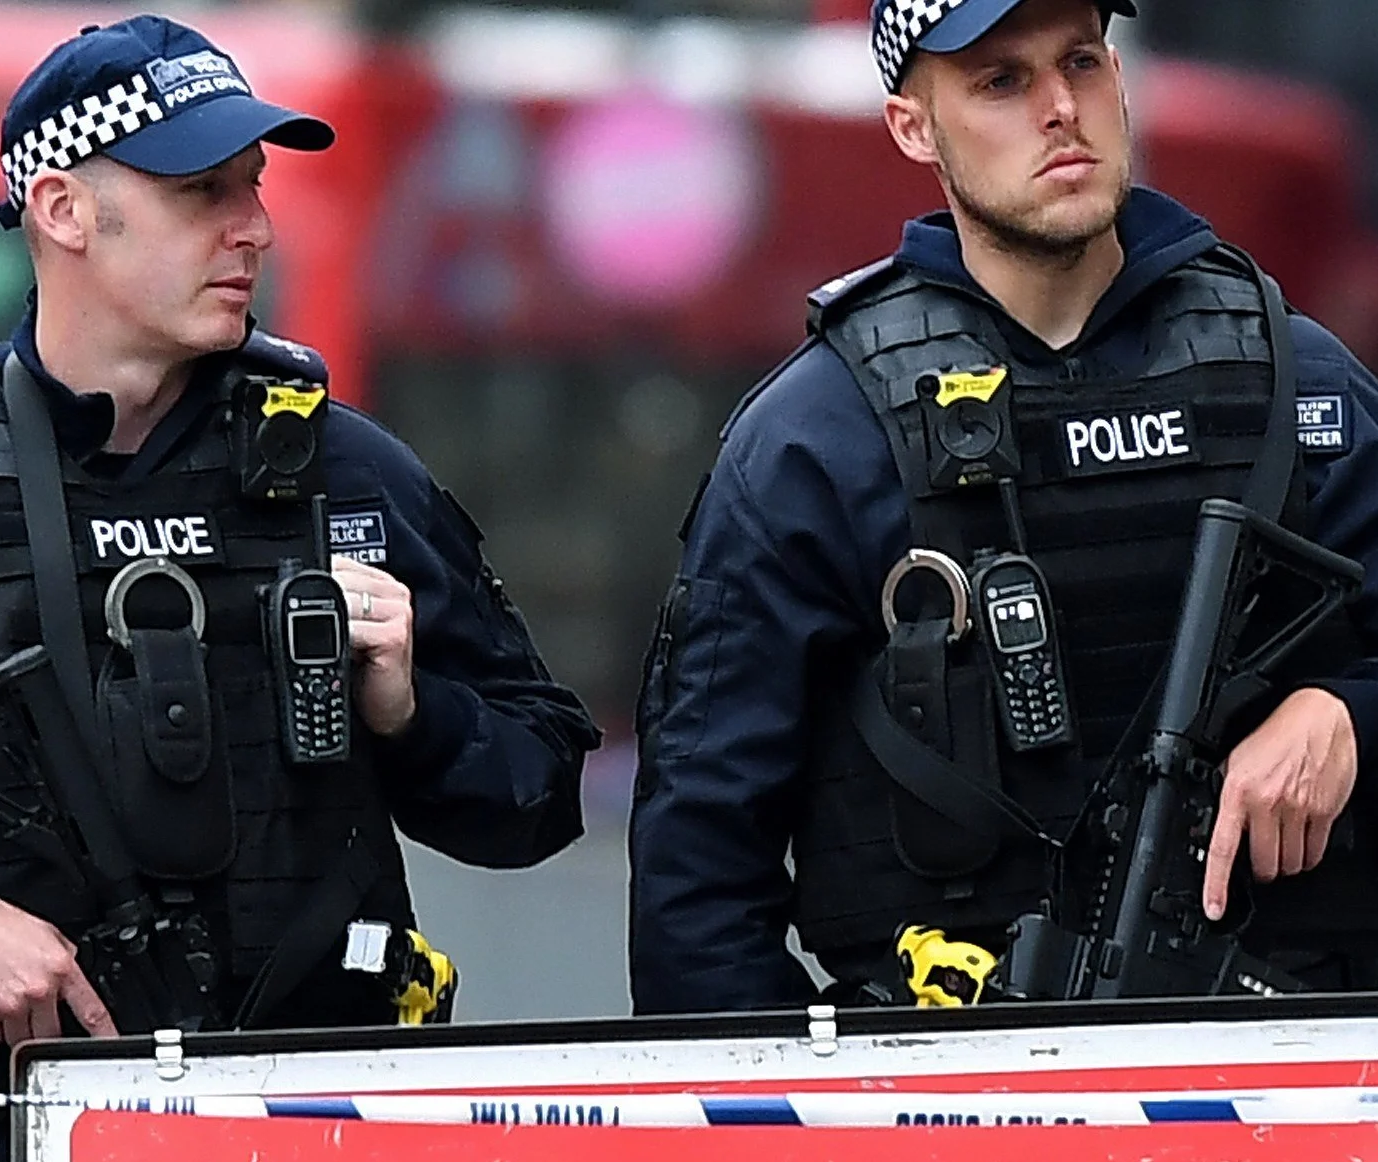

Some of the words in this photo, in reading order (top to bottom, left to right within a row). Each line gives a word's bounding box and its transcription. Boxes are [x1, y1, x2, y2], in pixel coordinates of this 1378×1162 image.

[1297, 410, 1322, 424] ICE
[1066, 409, 1189, 467] POLICE
[90, 516, 214, 558] POLICE
[330, 528, 366, 543] OLICE
